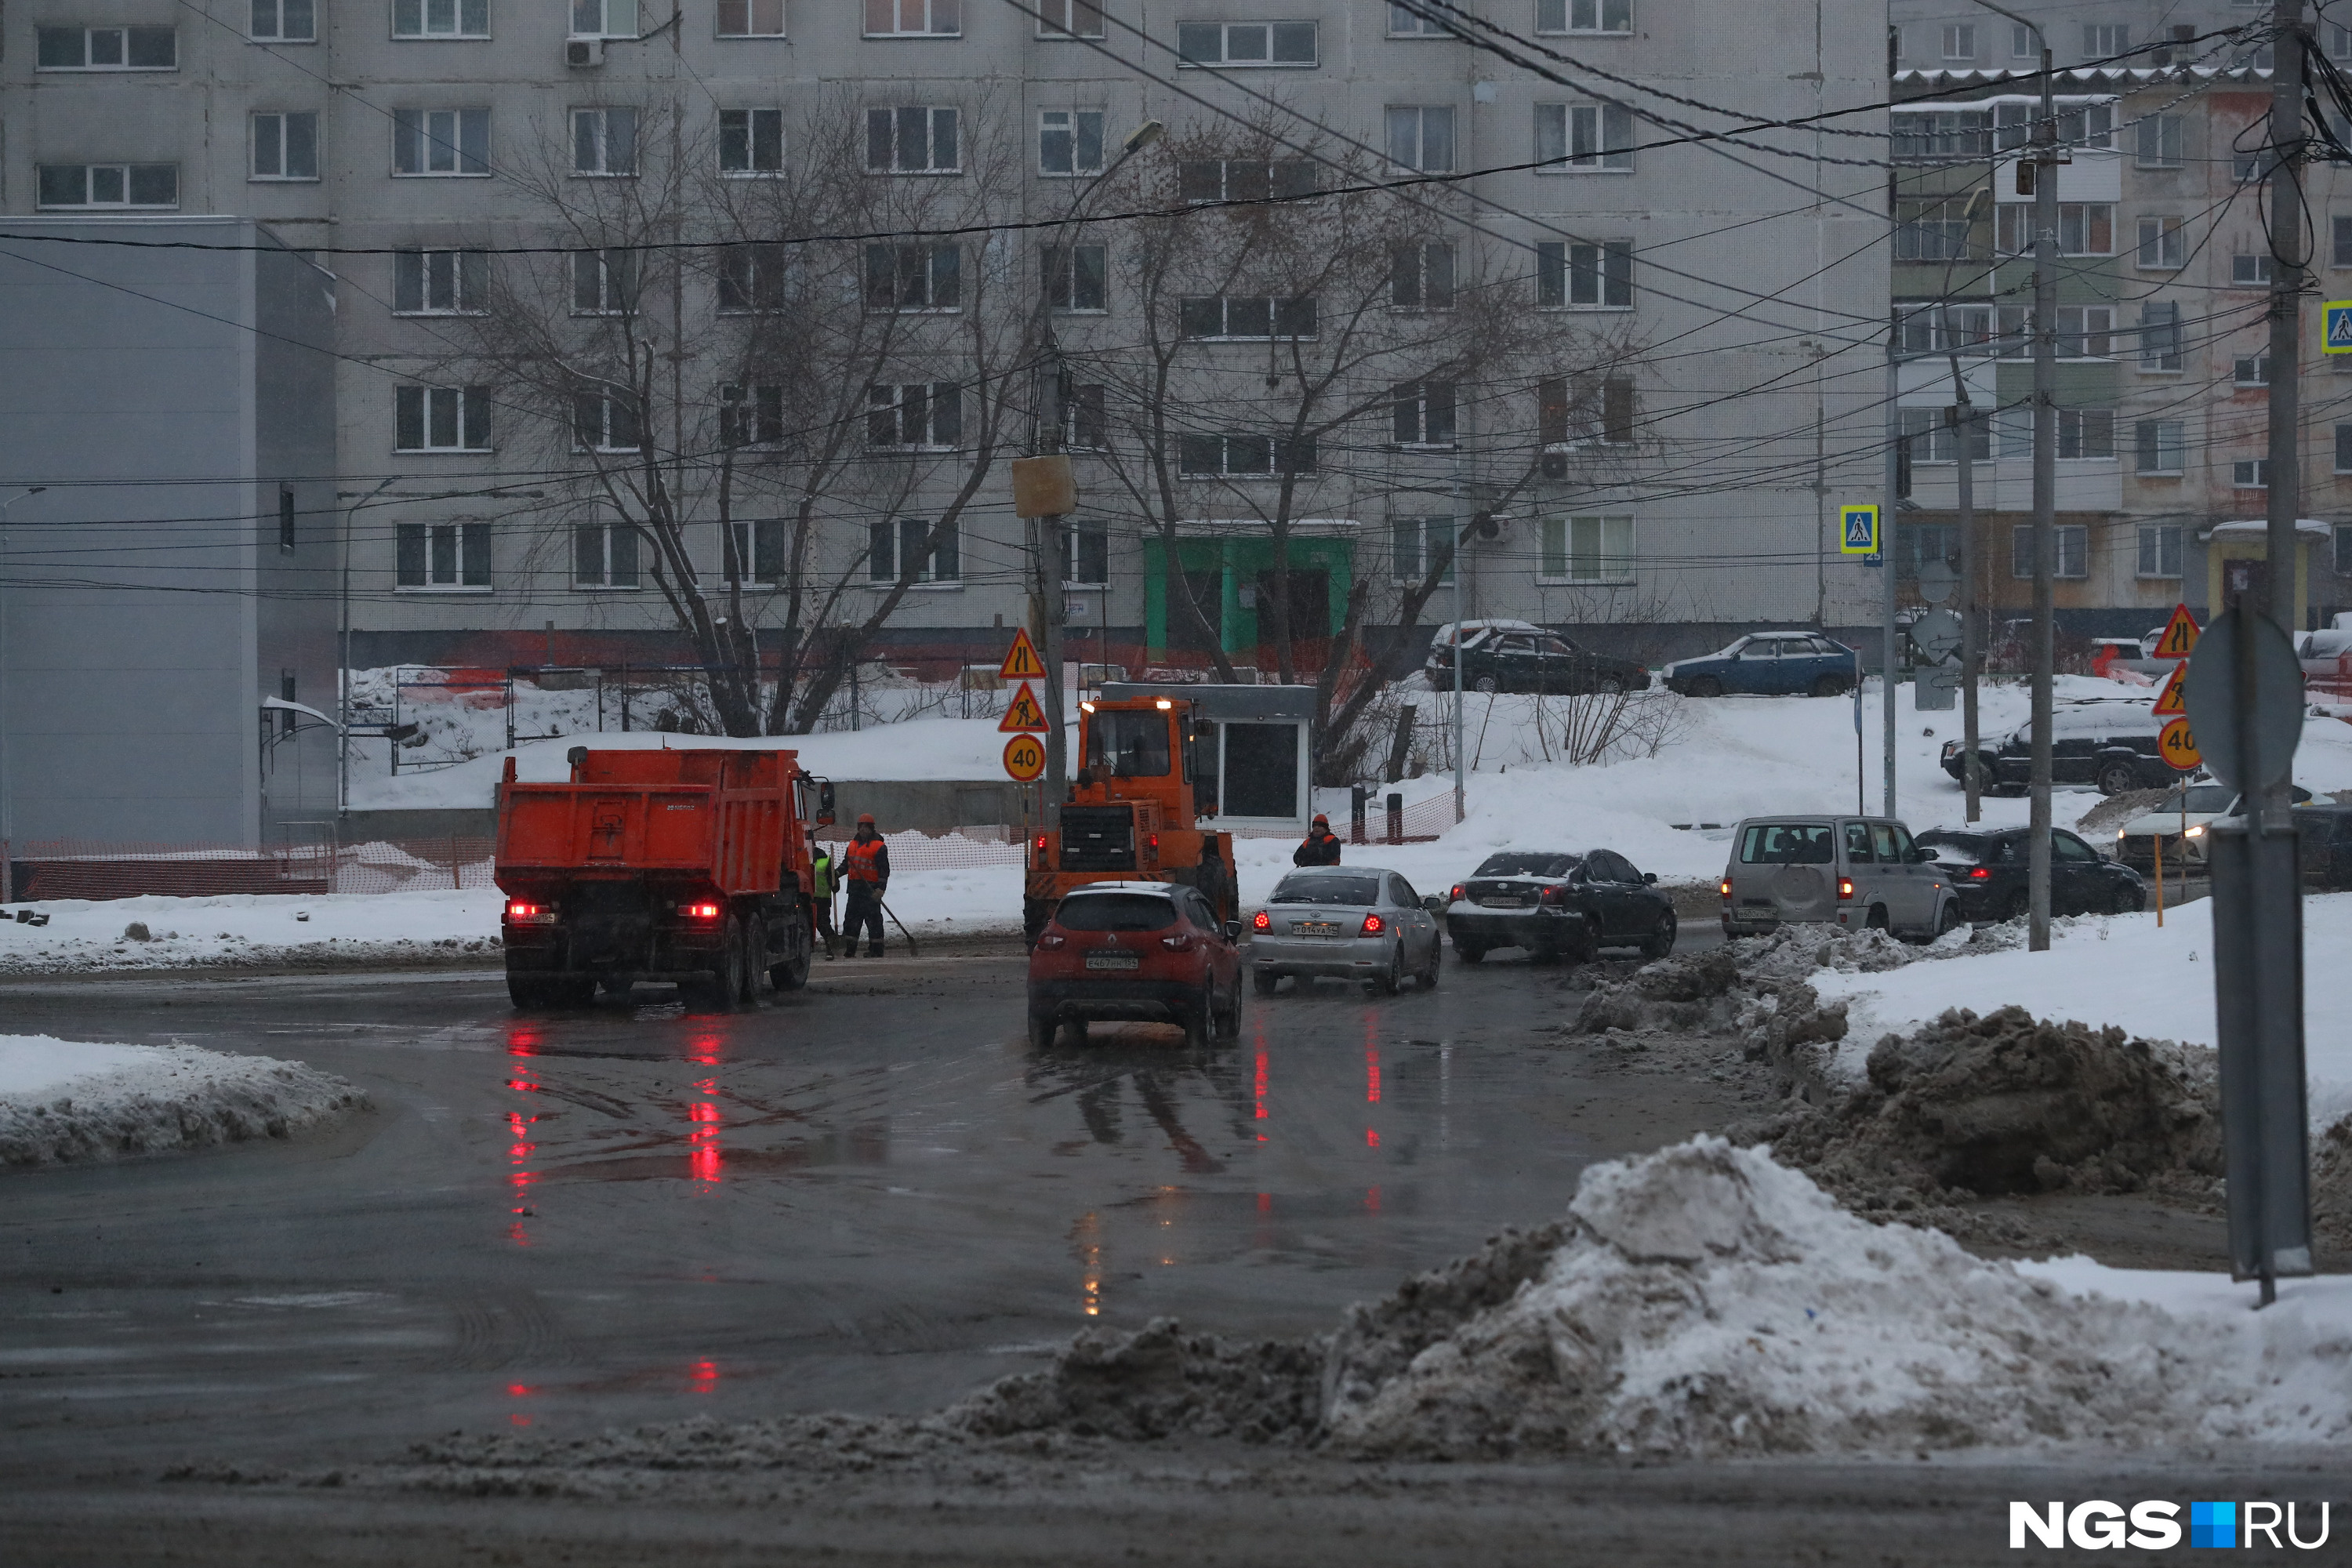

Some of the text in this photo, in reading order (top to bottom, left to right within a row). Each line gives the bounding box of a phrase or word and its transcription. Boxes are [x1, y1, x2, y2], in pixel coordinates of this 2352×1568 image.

[2168, 730, 2195, 750] 40
[1013, 749, 1036, 767] 40
[1088, 959, 1122, 967] Е467НН
